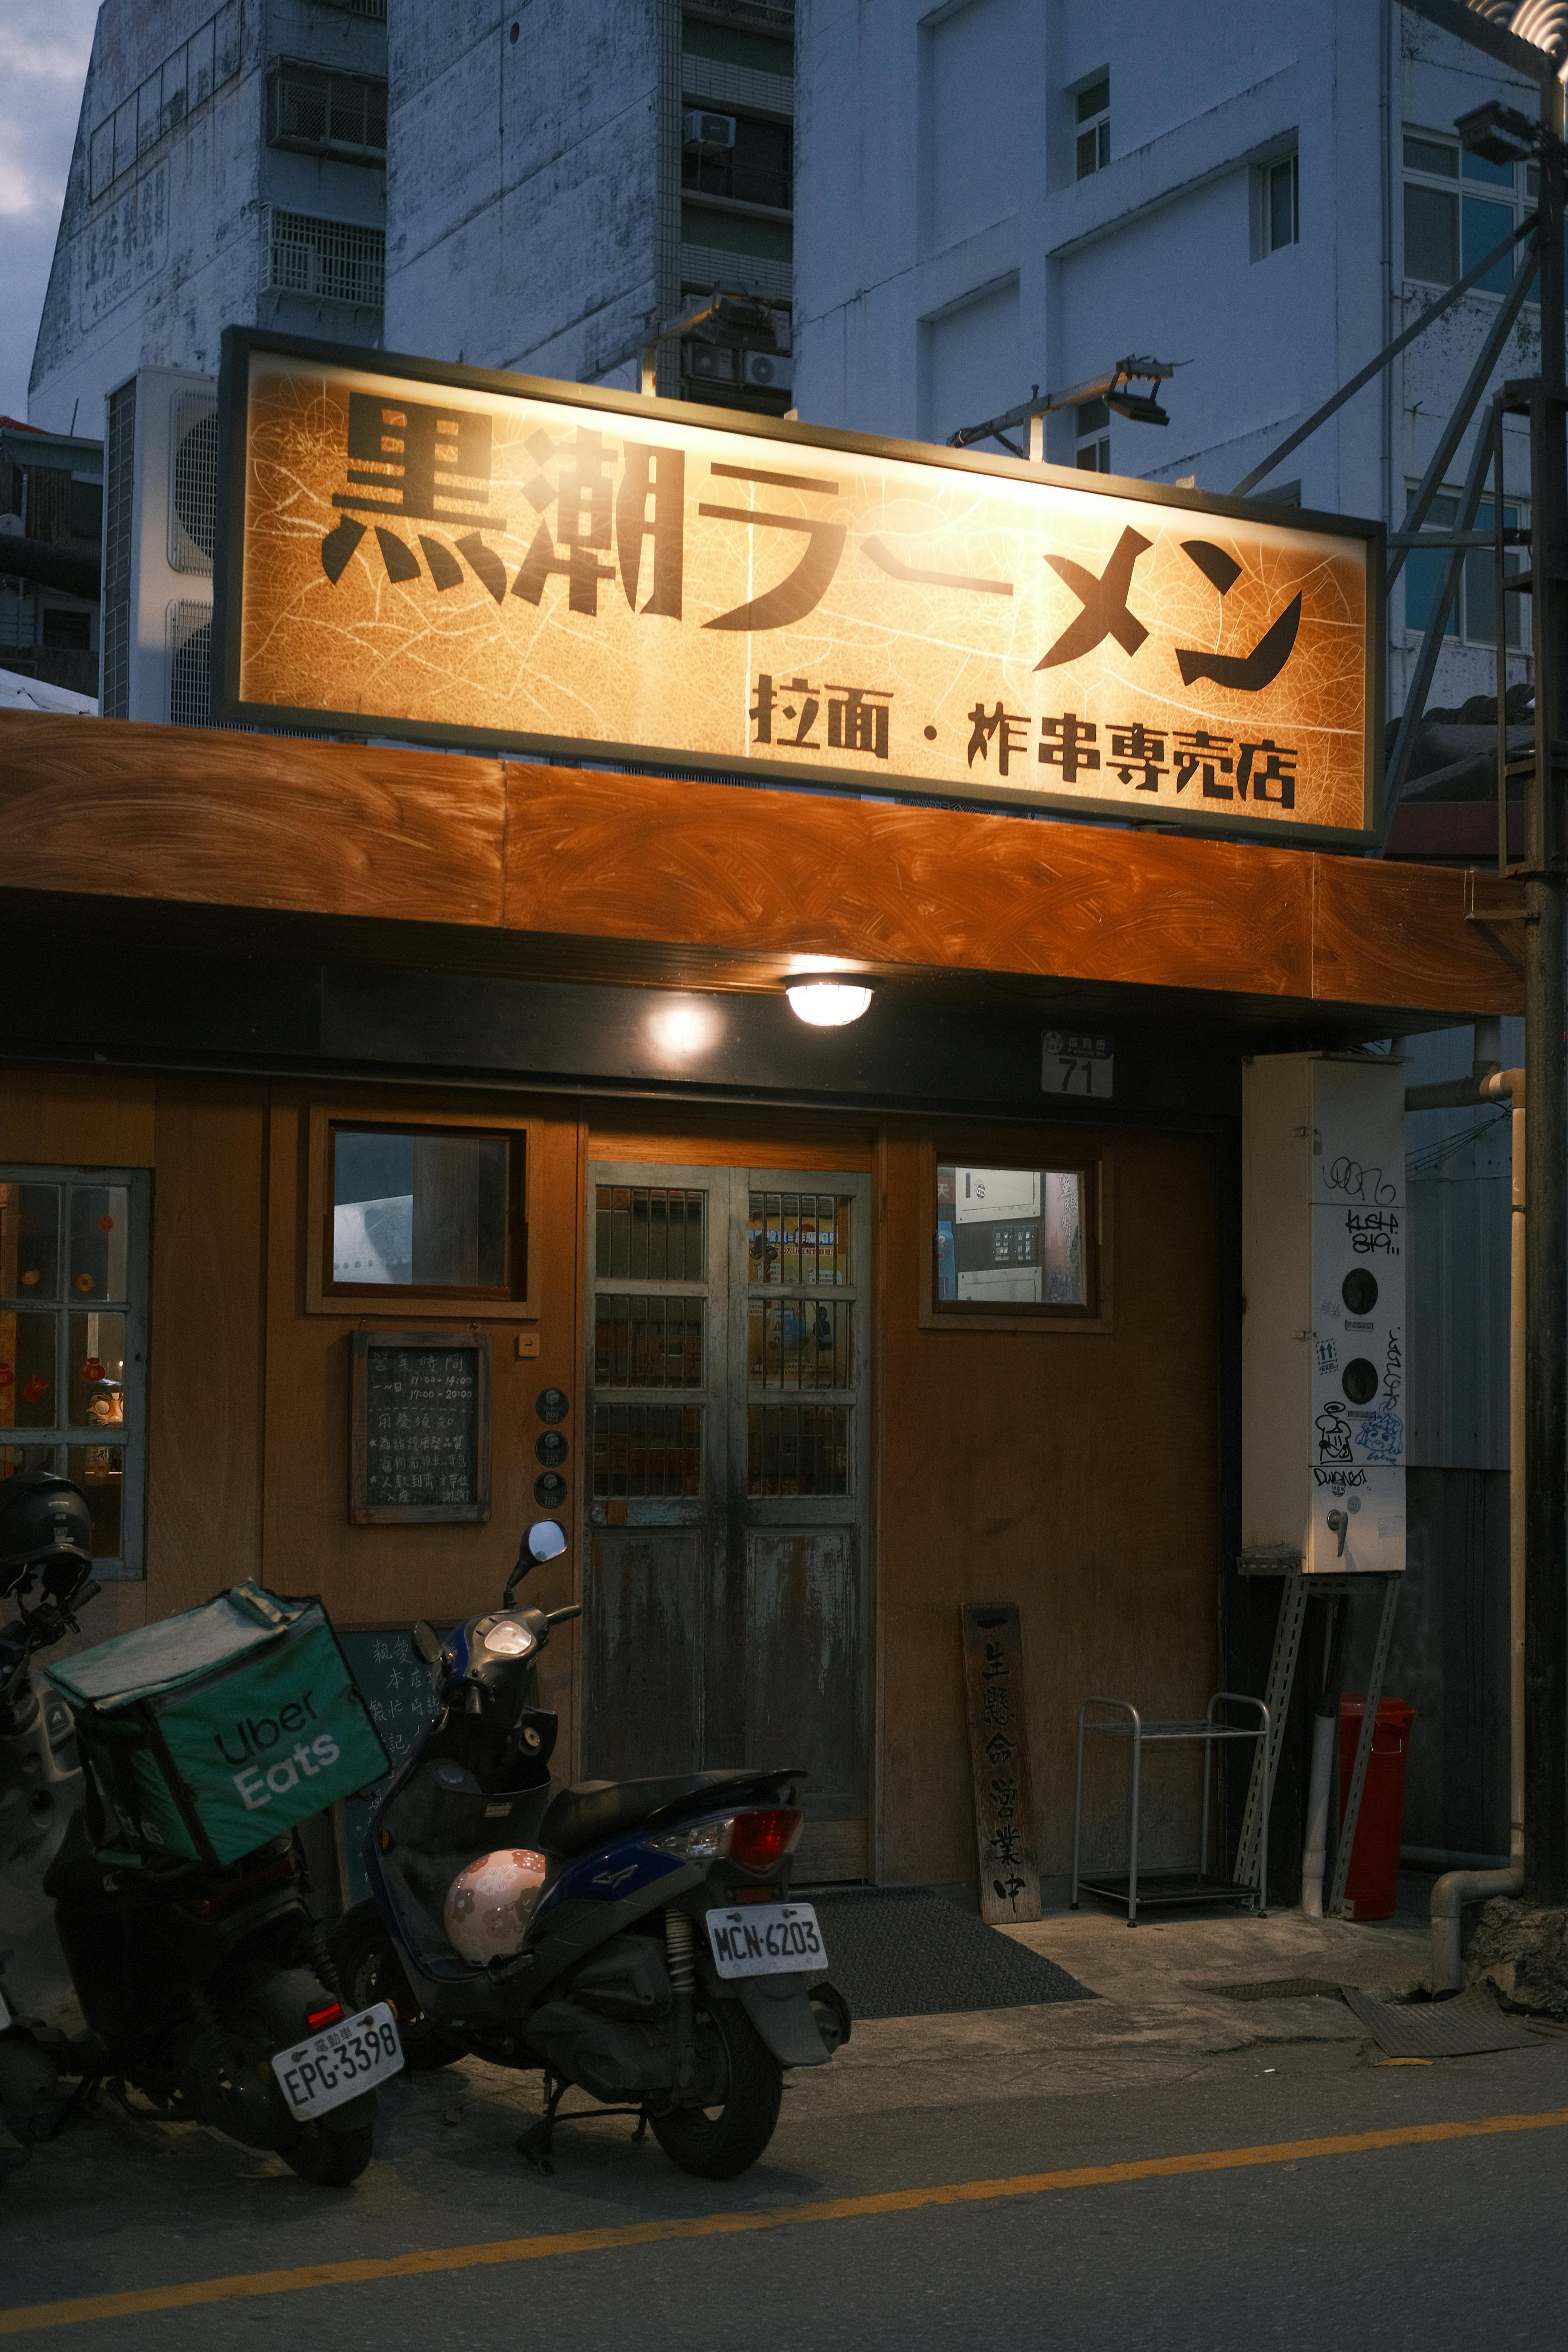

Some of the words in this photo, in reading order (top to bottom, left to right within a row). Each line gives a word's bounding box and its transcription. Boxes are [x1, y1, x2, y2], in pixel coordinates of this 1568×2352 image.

[321, 392, 1302, 691] 黒潮ラーメン
[1059, 1058, 1092, 1093] 71
[1321, 1363, 1336, 1371] EXEL
[378, 1412, 454, 1430] 用餐須知
[214, 1689, 318, 1765] Uber
[232, 1734, 340, 1810] Eats
[314, 2027, 352, 2053] 電動車
